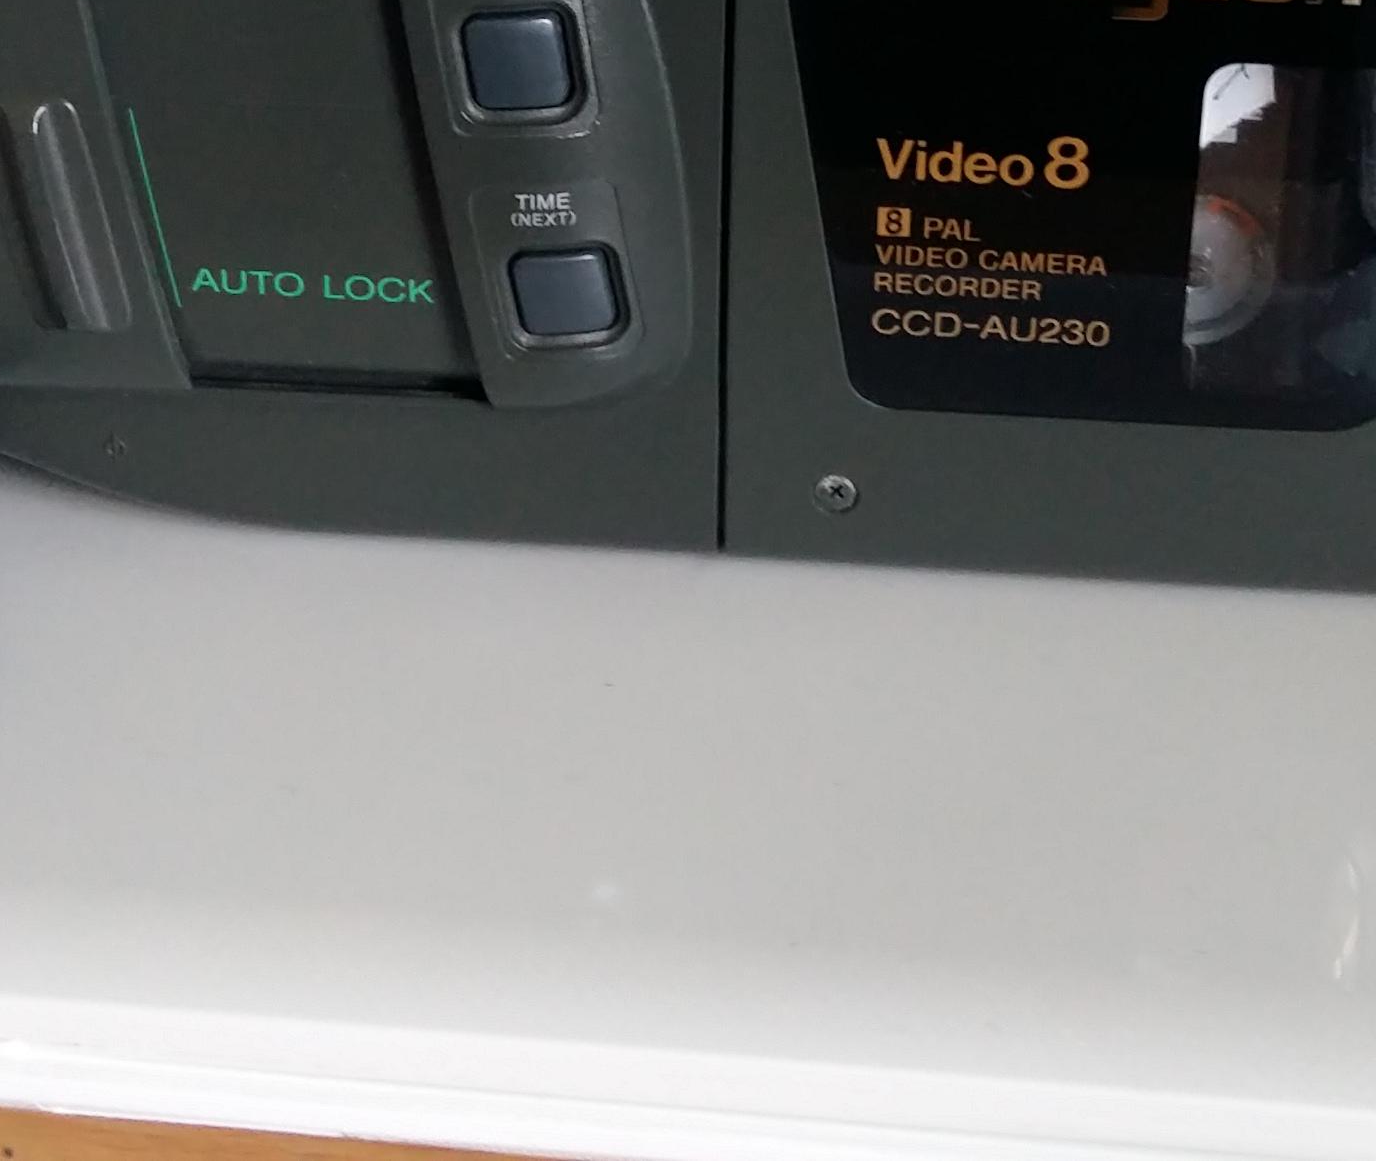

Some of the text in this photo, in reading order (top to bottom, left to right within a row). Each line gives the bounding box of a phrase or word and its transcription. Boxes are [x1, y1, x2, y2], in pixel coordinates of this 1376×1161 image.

[876, 136, 1090, 190] Video 8
[514, 192, 571, 210] TIME
[510, 210, 577, 227] (NEXT)
[881, 208, 981, 242] 8 PAL
[875, 244, 1107, 277] VIDEO CAMERA
[191, 268, 435, 304] AUTO LOCK
[873, 272, 1042, 301] RECORDER
[871, 308, 1111, 347] CCD-AU230
